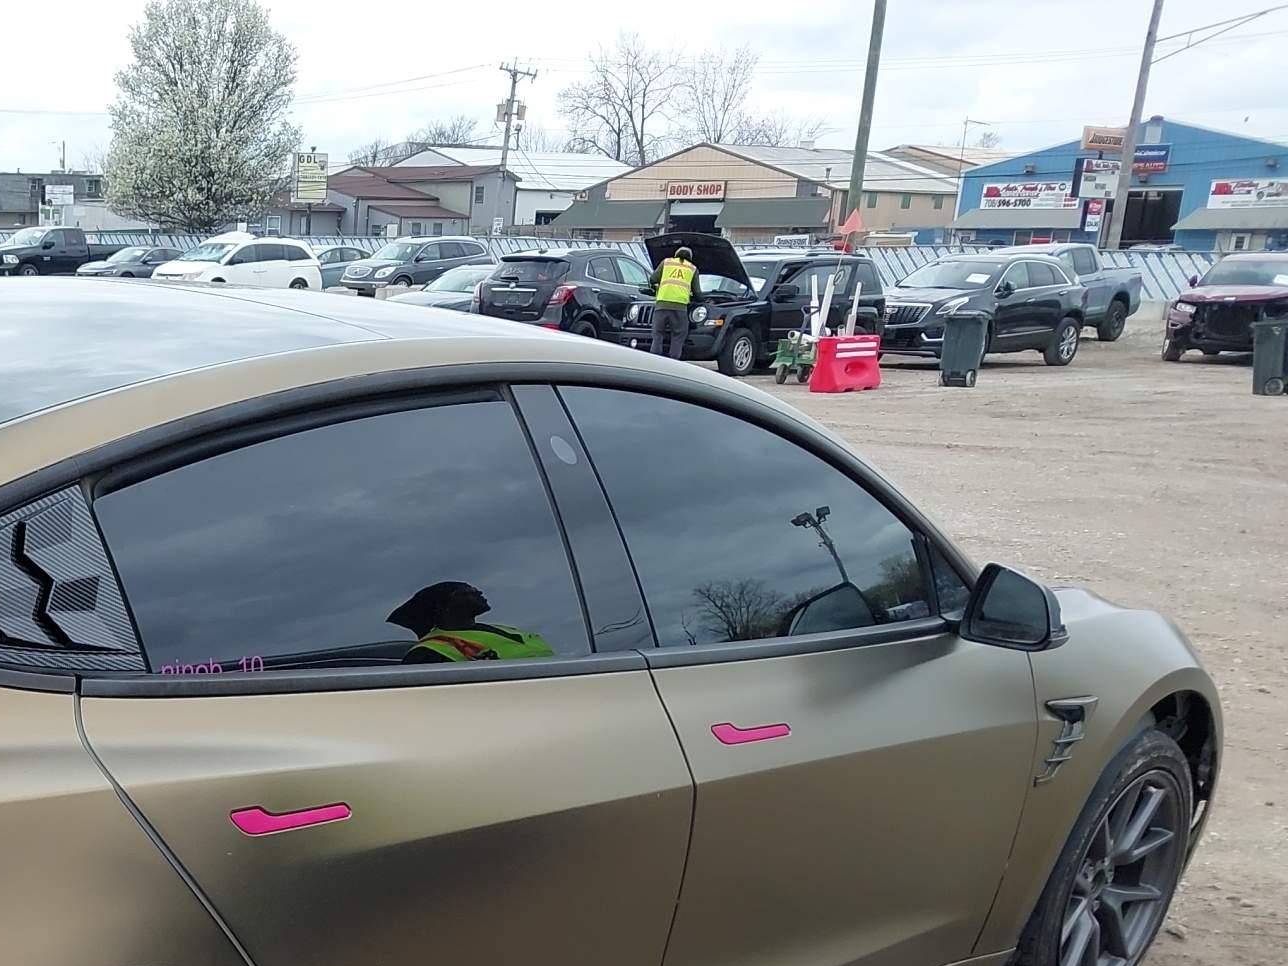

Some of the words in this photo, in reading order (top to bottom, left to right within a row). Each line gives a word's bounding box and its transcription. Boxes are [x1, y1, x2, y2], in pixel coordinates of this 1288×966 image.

[299, 154, 318, 164] GDL
[669, 185, 695, 196] BODY
[696, 183, 722, 196] SHOP
